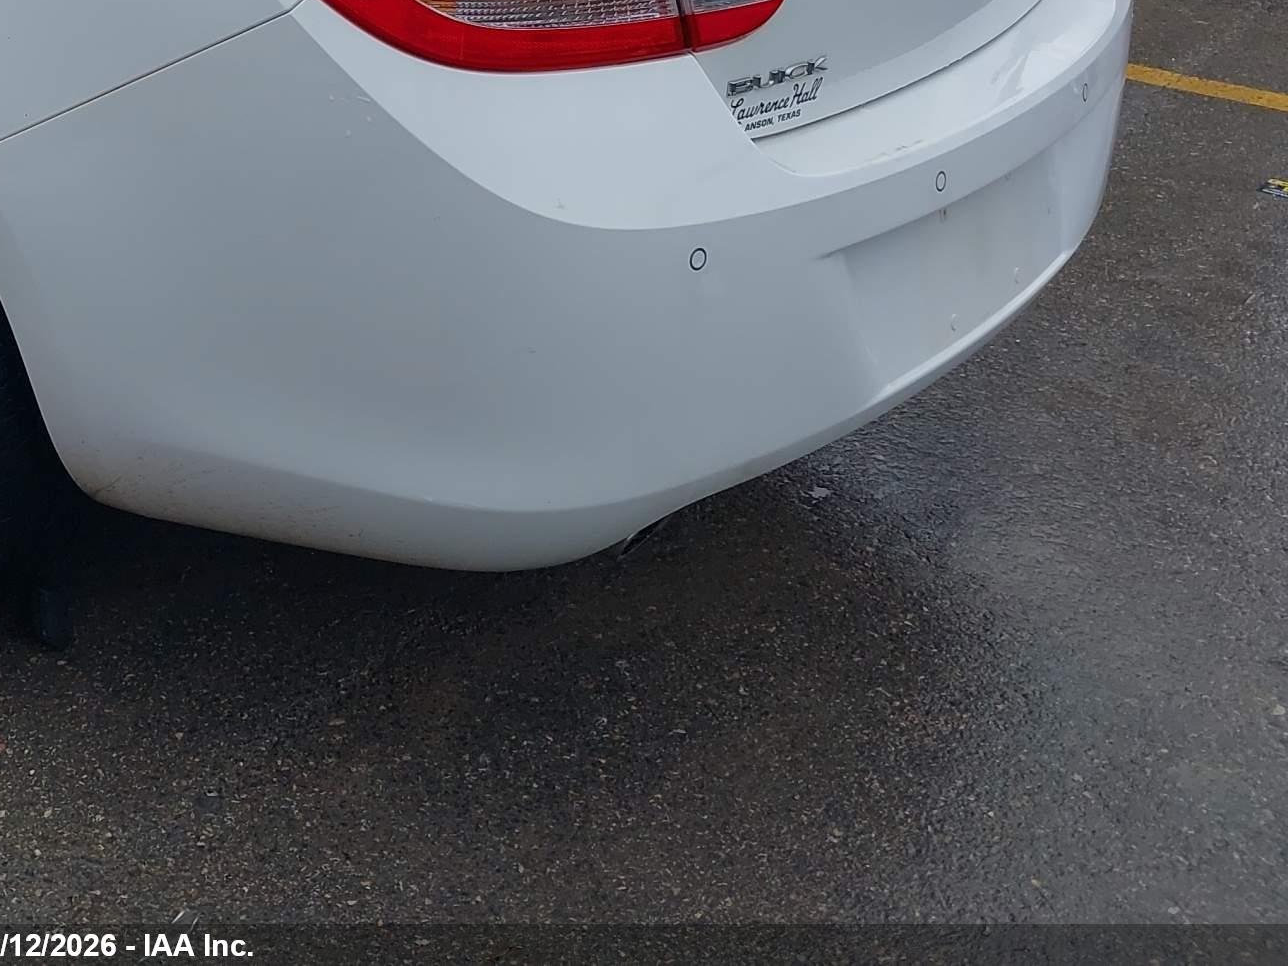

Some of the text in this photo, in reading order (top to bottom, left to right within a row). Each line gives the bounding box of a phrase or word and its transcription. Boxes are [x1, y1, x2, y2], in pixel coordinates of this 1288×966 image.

[726, 55, 828, 97] BUICK
[730, 76, 823, 121] Lawrence Hall
[744, 109, 801, 132] ANSON, TEXAS
